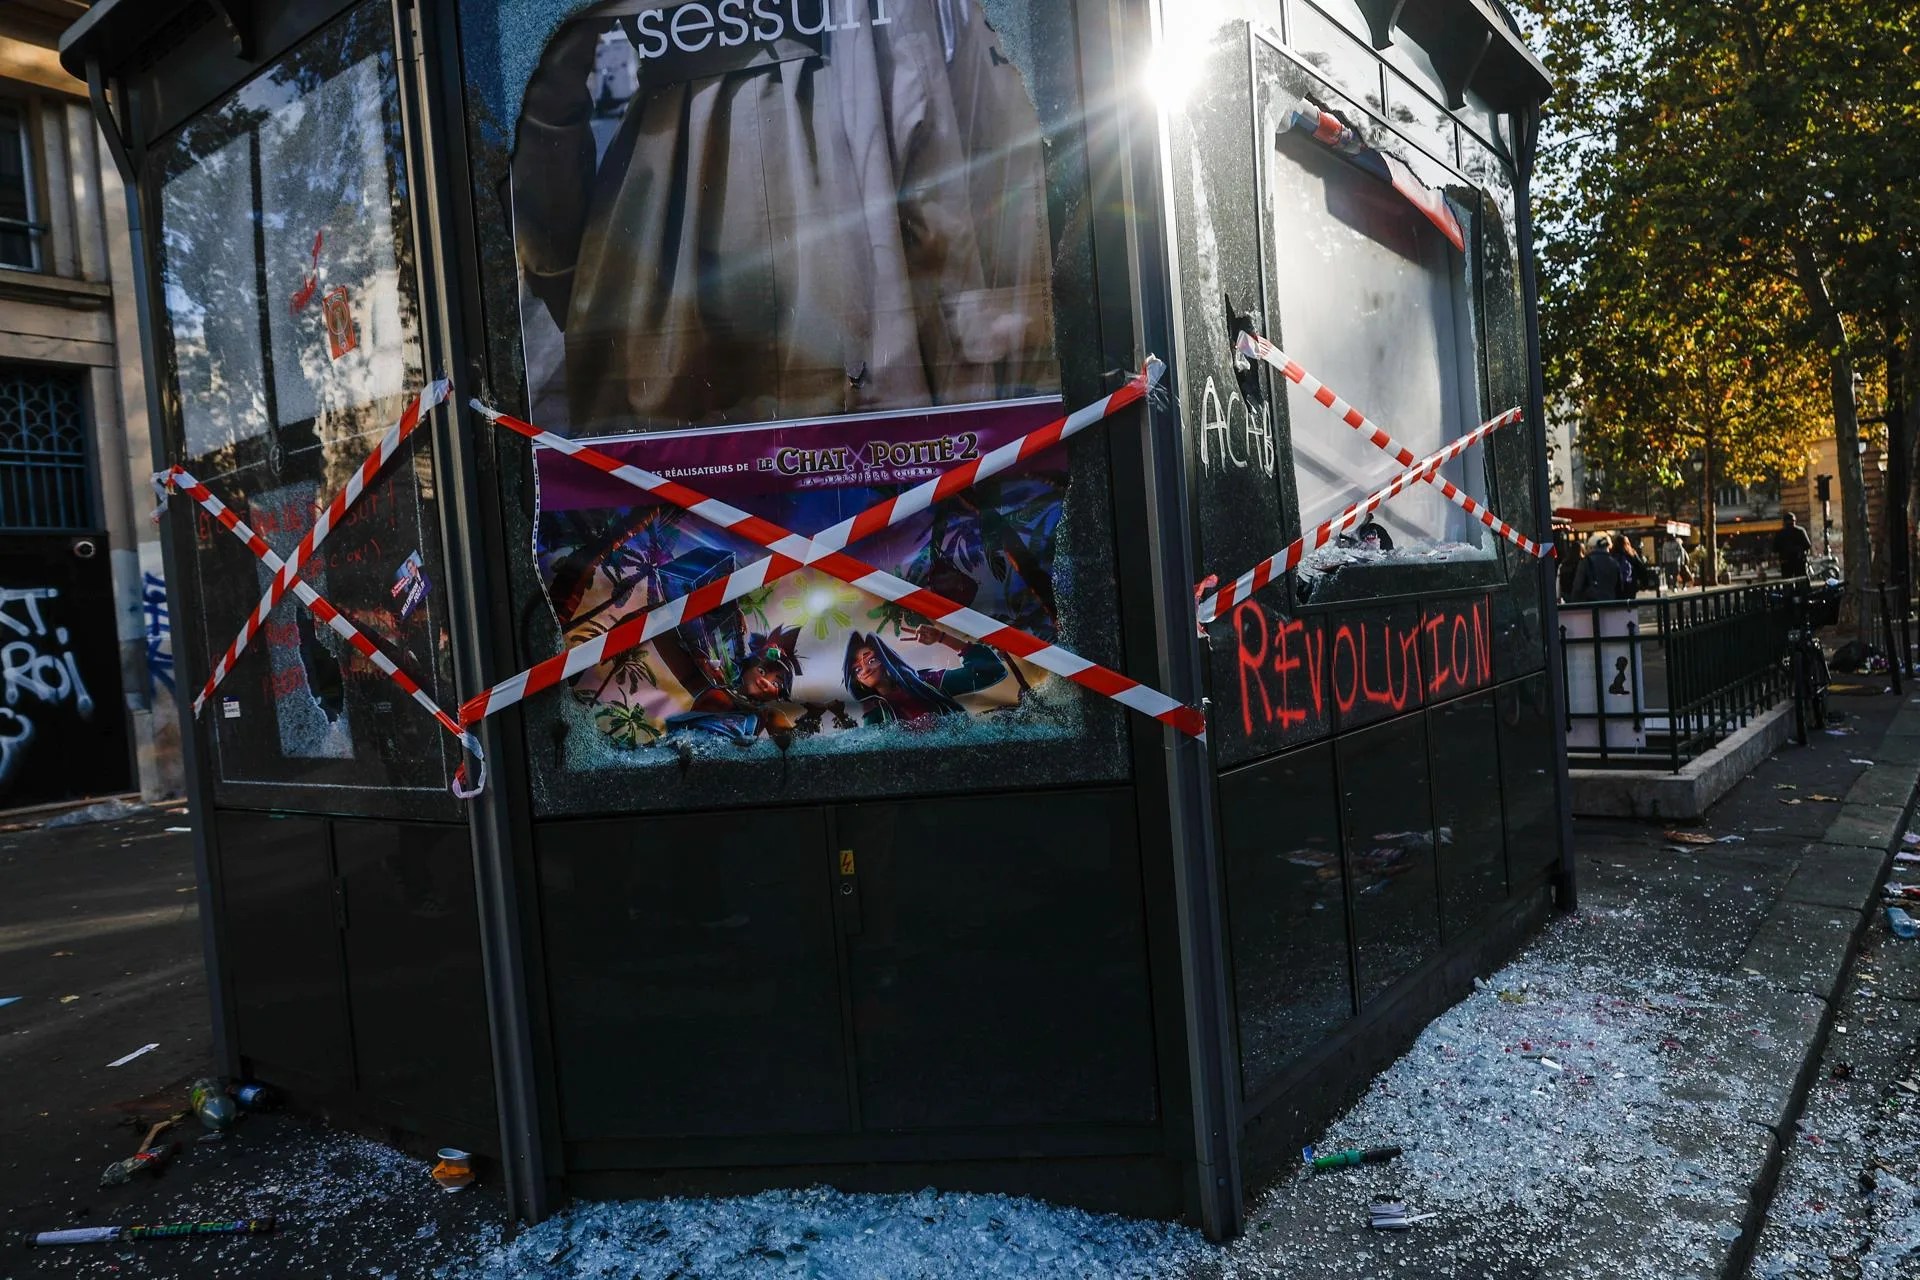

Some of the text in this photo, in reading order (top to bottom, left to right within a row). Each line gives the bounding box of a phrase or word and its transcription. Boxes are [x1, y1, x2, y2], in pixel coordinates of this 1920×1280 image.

[665, 465, 734, 478] RÉALISATEURS
[736, 463, 749, 472] DE
[758, 457, 773, 471] LE
[776, 446, 849, 476] CHAT
[868, 435, 956, 469] POTTÉ
[957, 432, 980, 461] 2
[1200, 376, 1274, 479] ACAB
[1232, 592, 1492, 737] REVOLUTION
